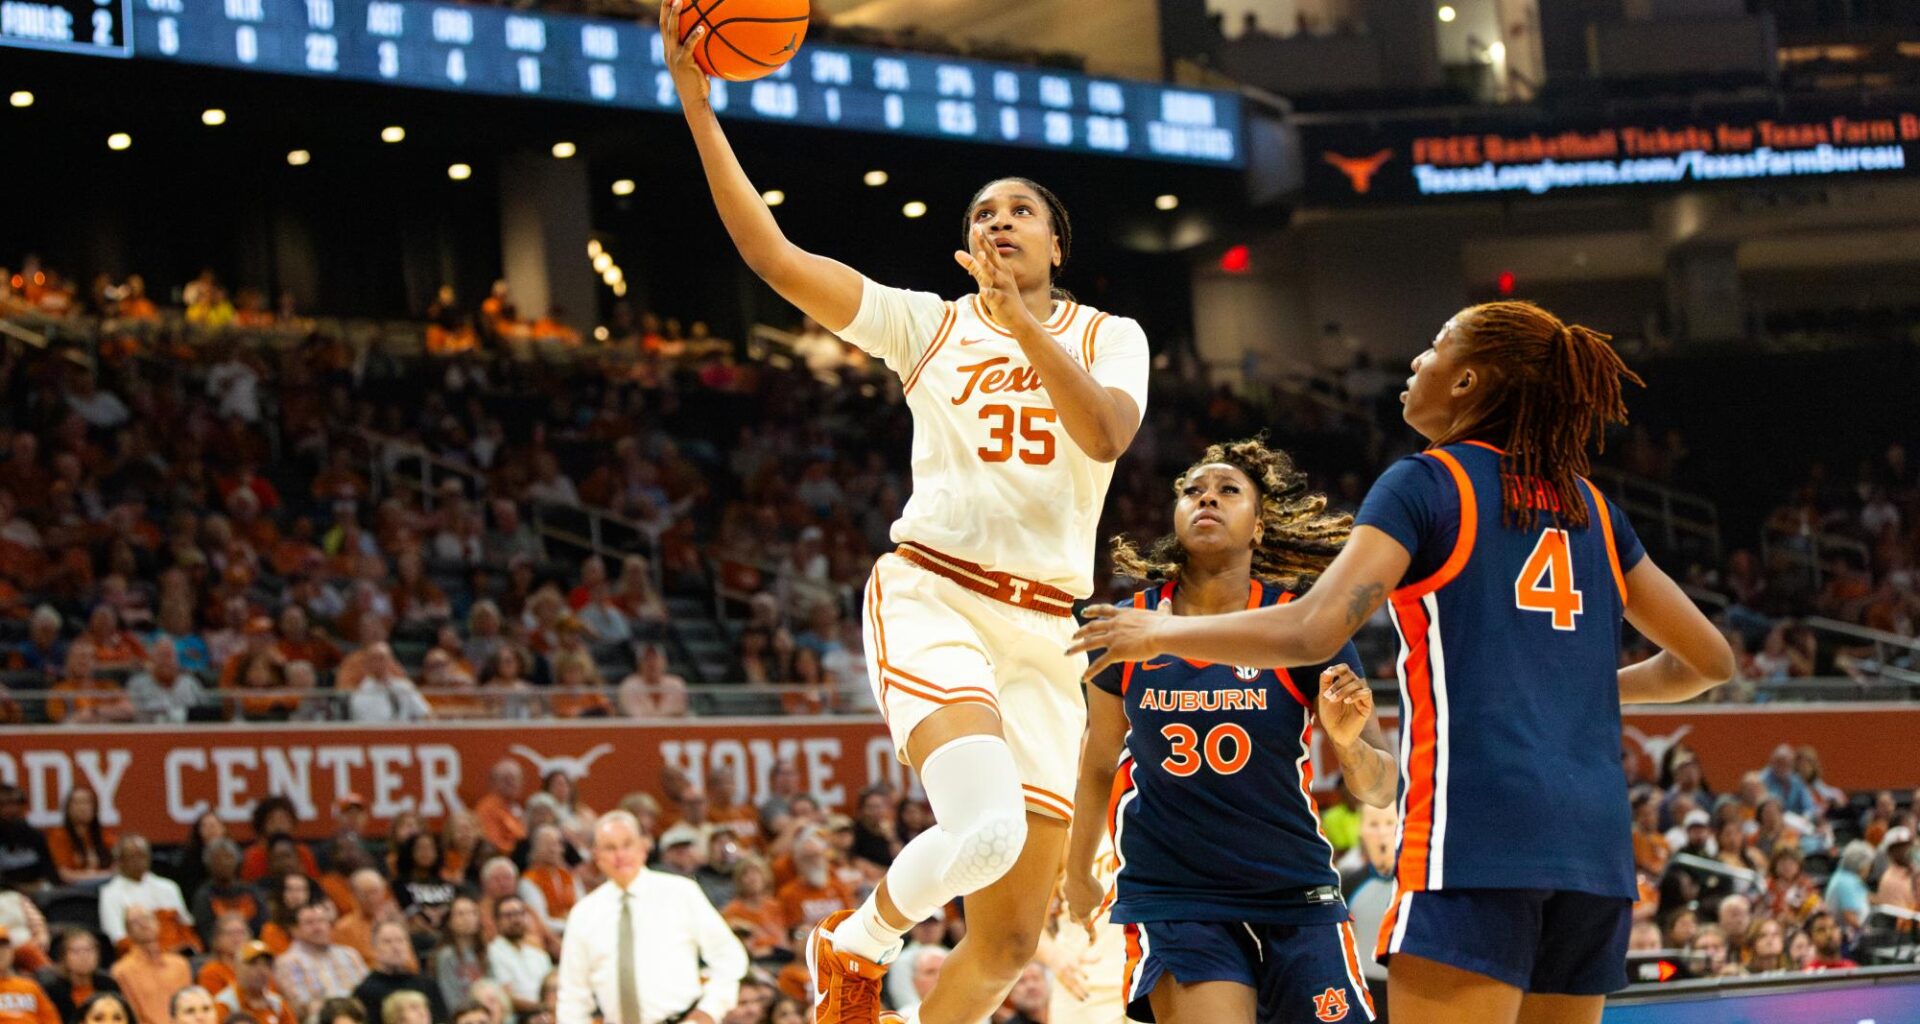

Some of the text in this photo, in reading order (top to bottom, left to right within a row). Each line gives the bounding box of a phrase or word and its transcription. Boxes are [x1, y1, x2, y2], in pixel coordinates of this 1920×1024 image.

[1412, 136, 1482, 165] FREE
[1483, 130, 1617, 163] Basketball
[1620, 126, 1713, 157] Tickets
[1716, 122, 1754, 151] for
[1757, 119, 1830, 147] Texas
[1832, 115, 1896, 143] Farm
[1413, 143, 1905, 195] TexasLonghorns.com/TexasFarmBureau
[951, 356, 1043, 406] Tex
[977, 403, 1057, 466] 35
[1009, 577, 1030, 604] T
[1515, 527, 1584, 632] 4
[1139, 688, 1268, 712] AUBURN
[1160, 722, 1252, 777] 30
[164, 743, 470, 821] CENTER
